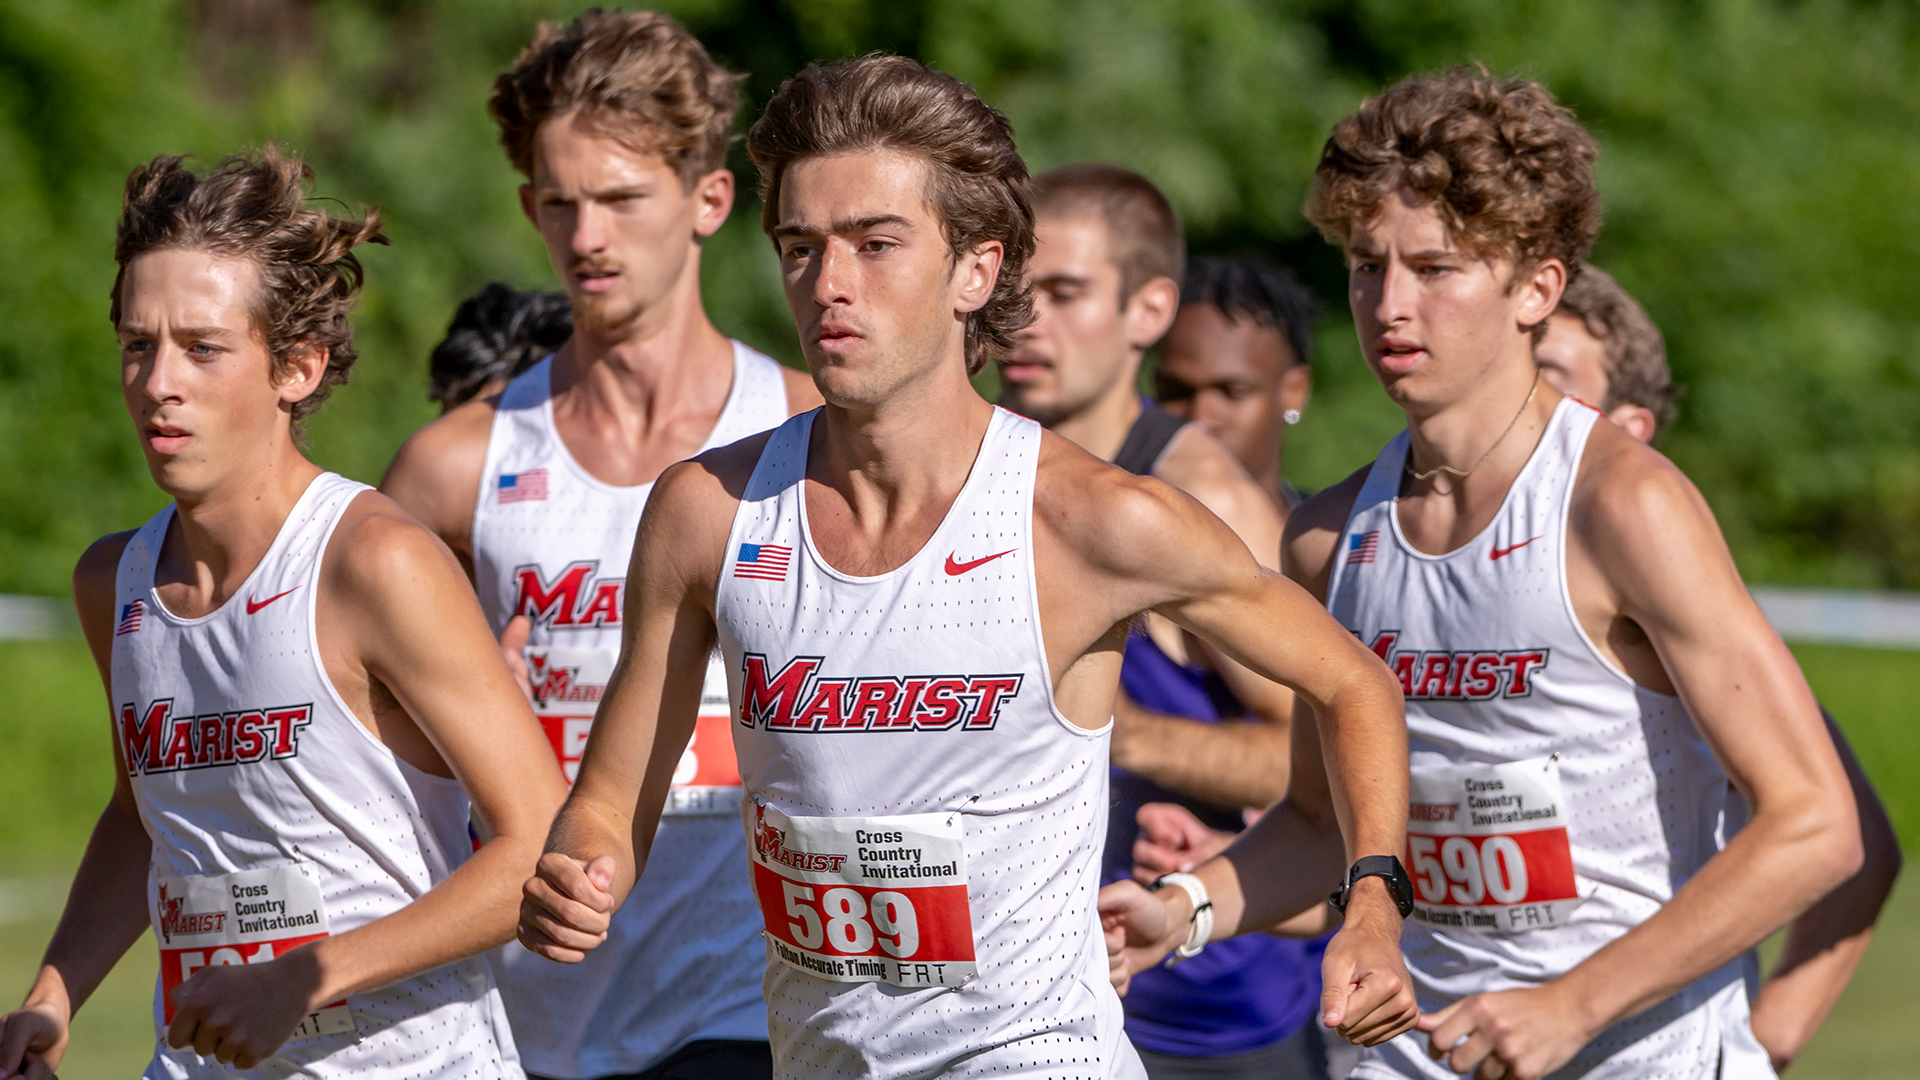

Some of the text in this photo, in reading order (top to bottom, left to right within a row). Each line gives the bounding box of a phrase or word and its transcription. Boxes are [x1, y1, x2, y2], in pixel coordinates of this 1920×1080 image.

[1349, 629, 1550, 700] ARIST
[740, 652, 1025, 732] MARIST
[121, 697, 314, 777] MARIST
[1465, 778, 1504, 793] Cross
[1468, 794, 1523, 809] Country
[1471, 804, 1557, 826] Invitational
[856, 829, 903, 845] Cross
[760, 832, 847, 873] MARIST
[858, 847, 922, 863] Country
[860, 861, 958, 879] Invitational
[1408, 835, 1528, 904] 590
[232, 884, 268, 898] Cross
[235, 900, 286, 916] Country
[781, 879, 920, 959] 589
[165, 909, 228, 936] MARIST
[238, 910, 319, 934] Invitational
[774, 939, 946, 984] Fulton Accurate Timing FAT
